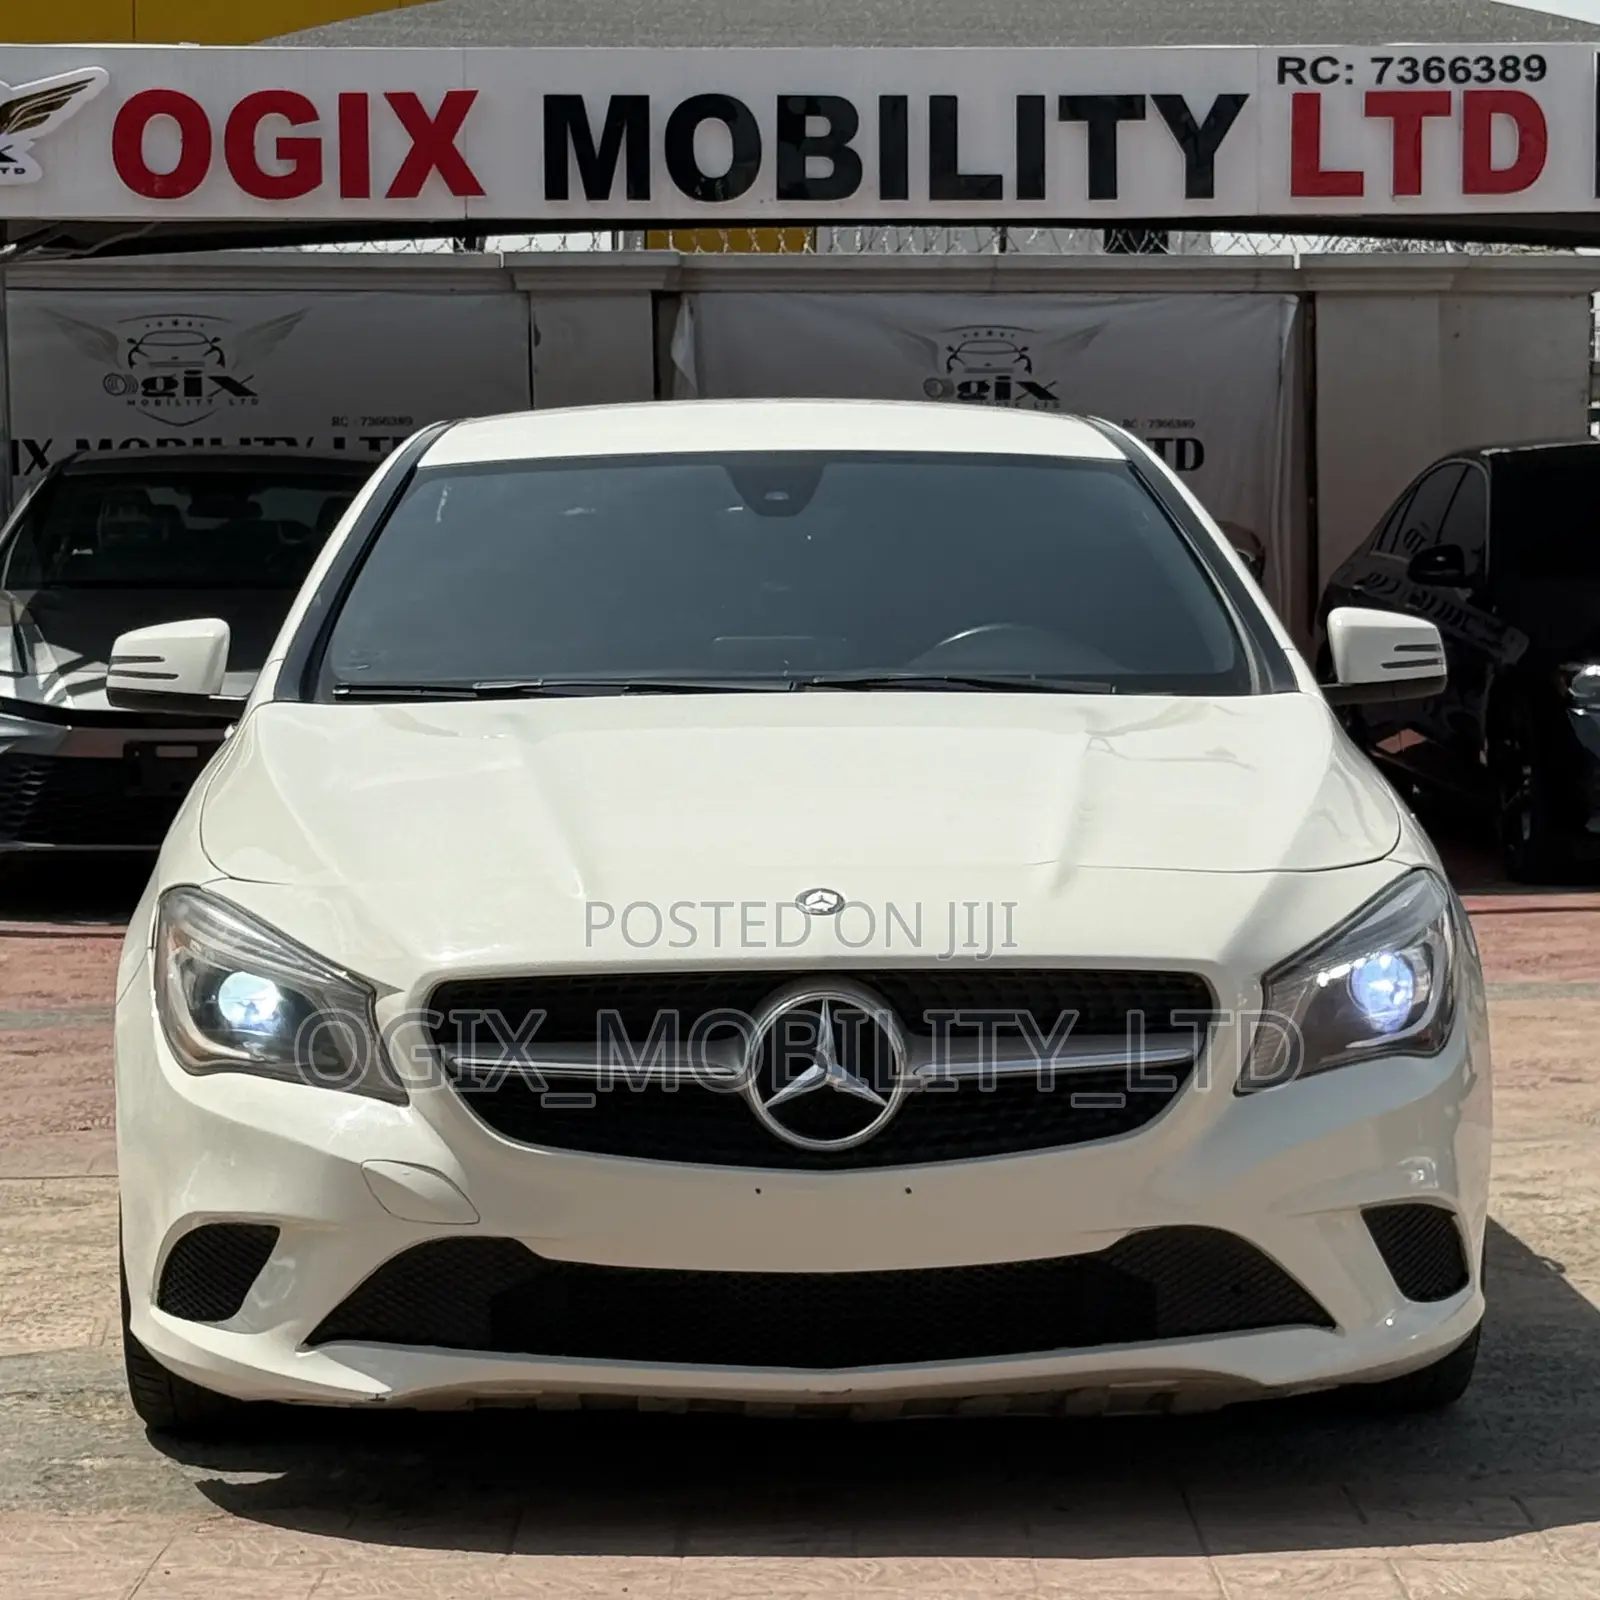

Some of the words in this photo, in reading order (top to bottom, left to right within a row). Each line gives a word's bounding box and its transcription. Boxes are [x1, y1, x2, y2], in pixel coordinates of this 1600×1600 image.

[1277, 55, 1354, 85] RC:
[1371, 54, 1547, 85] 7366389
[112, 90, 486, 200] OGIX
[544, 94, 1250, 201] MOBILITY
[1291, 90, 1547, 197] LTD
[126, 398, 214, 407] MOBILITY
[229, 398, 260, 407] LTD
